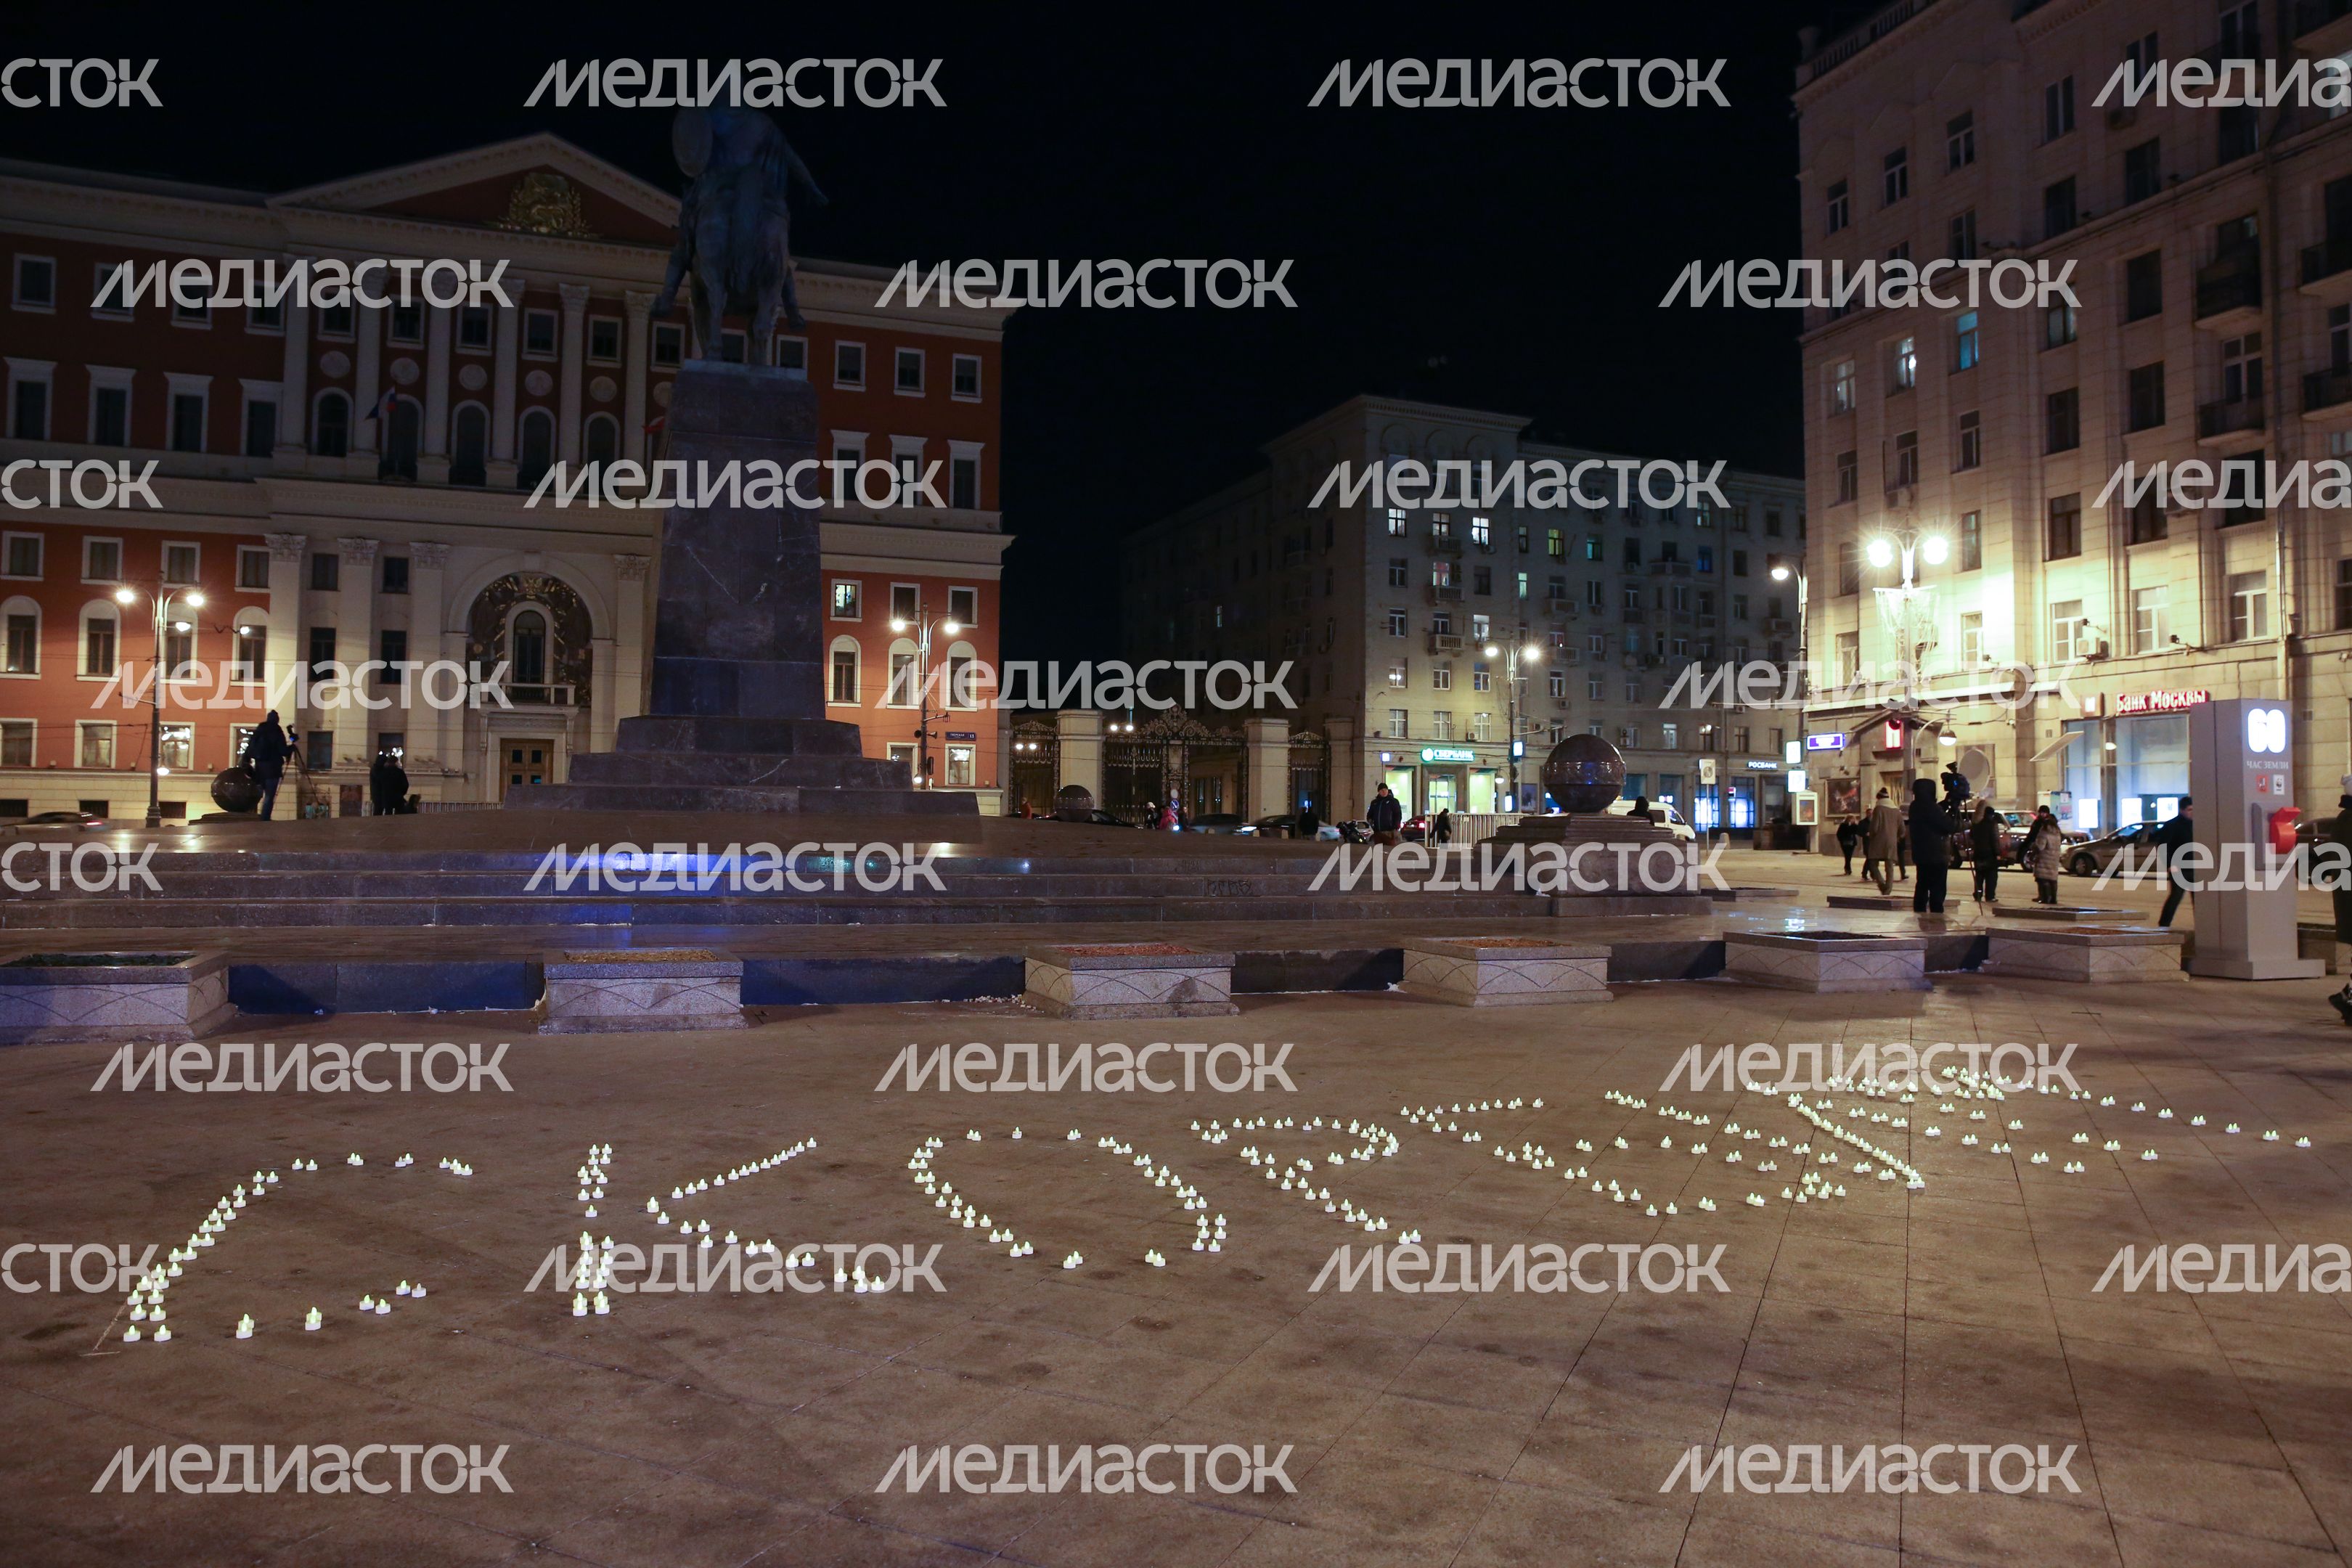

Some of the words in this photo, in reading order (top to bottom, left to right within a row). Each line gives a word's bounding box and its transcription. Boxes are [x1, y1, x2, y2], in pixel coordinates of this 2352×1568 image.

[2116, 693, 2147, 712] Банк
[2150, 689, 2206, 709] Москвы
[1434, 748, 1474, 758] СБЕРБАНК
[2247, 760, 2262, 769] ЧАС
[2263, 760, 2289, 770] ЗЕМЛИ
